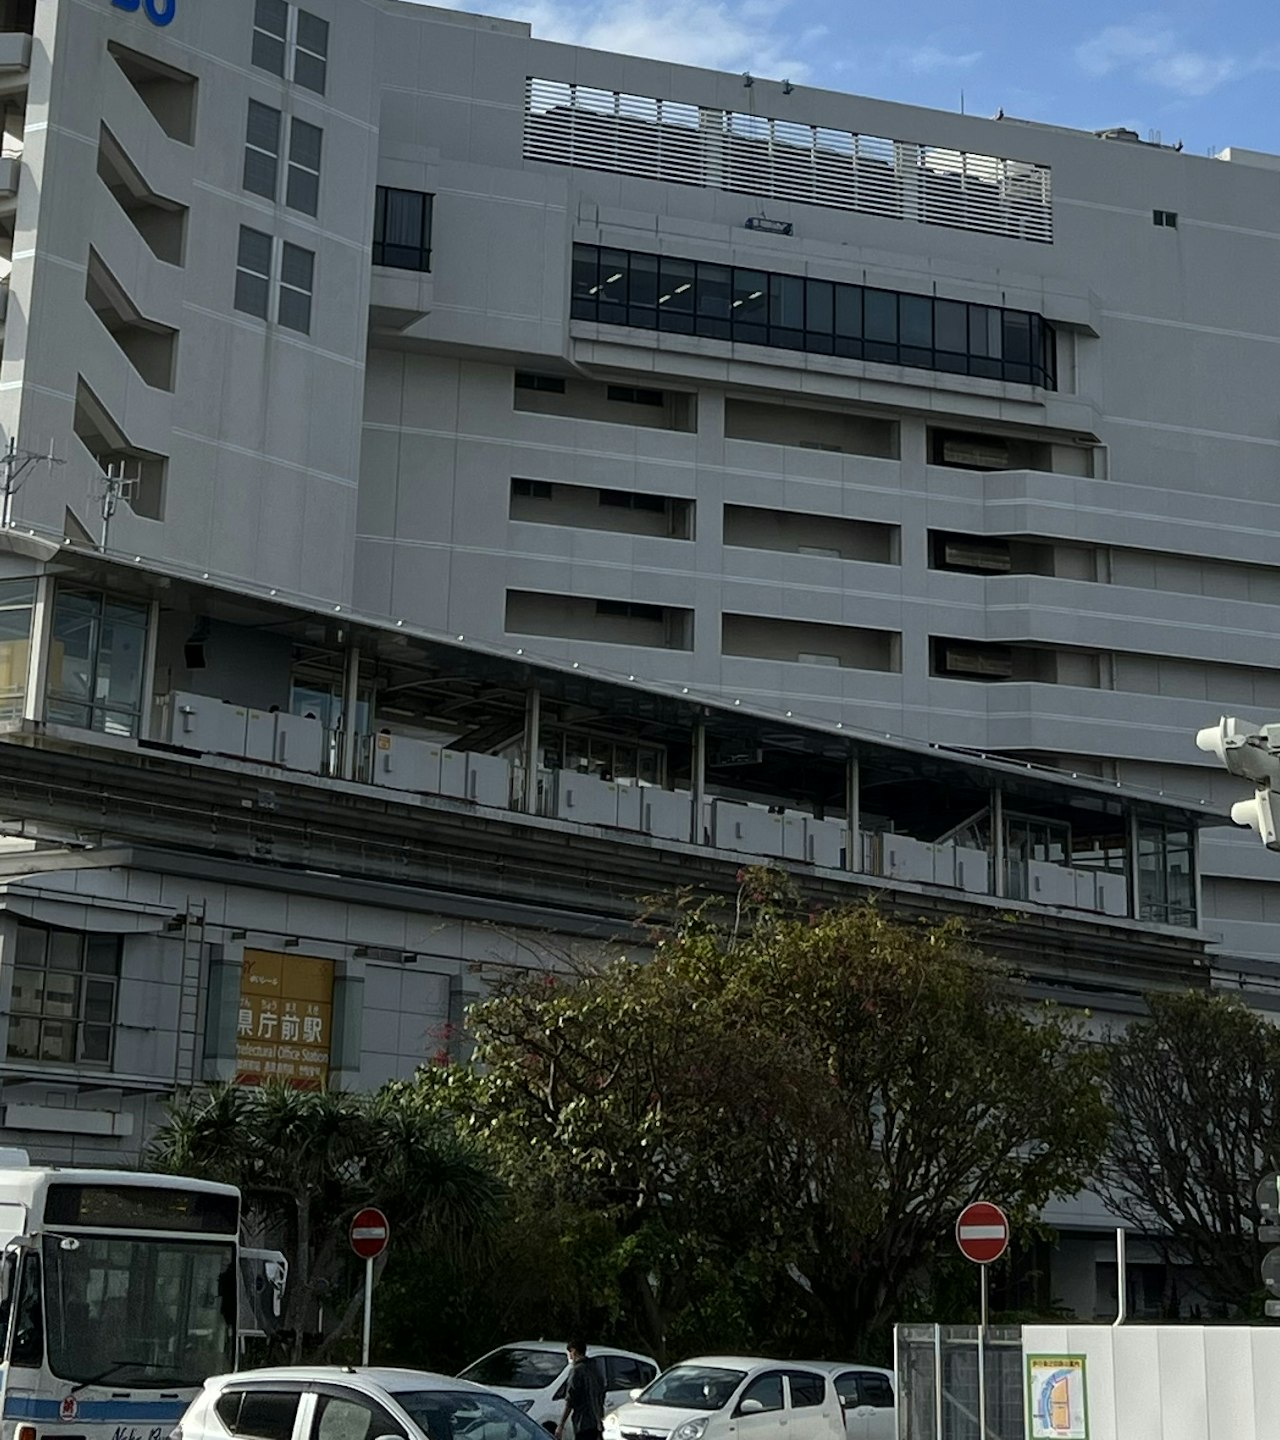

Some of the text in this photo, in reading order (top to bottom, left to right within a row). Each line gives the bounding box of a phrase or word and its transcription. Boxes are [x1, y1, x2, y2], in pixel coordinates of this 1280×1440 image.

[237, 1009, 322, 1042] 県庁前駅
[277, 1045, 301, 1061] Office
